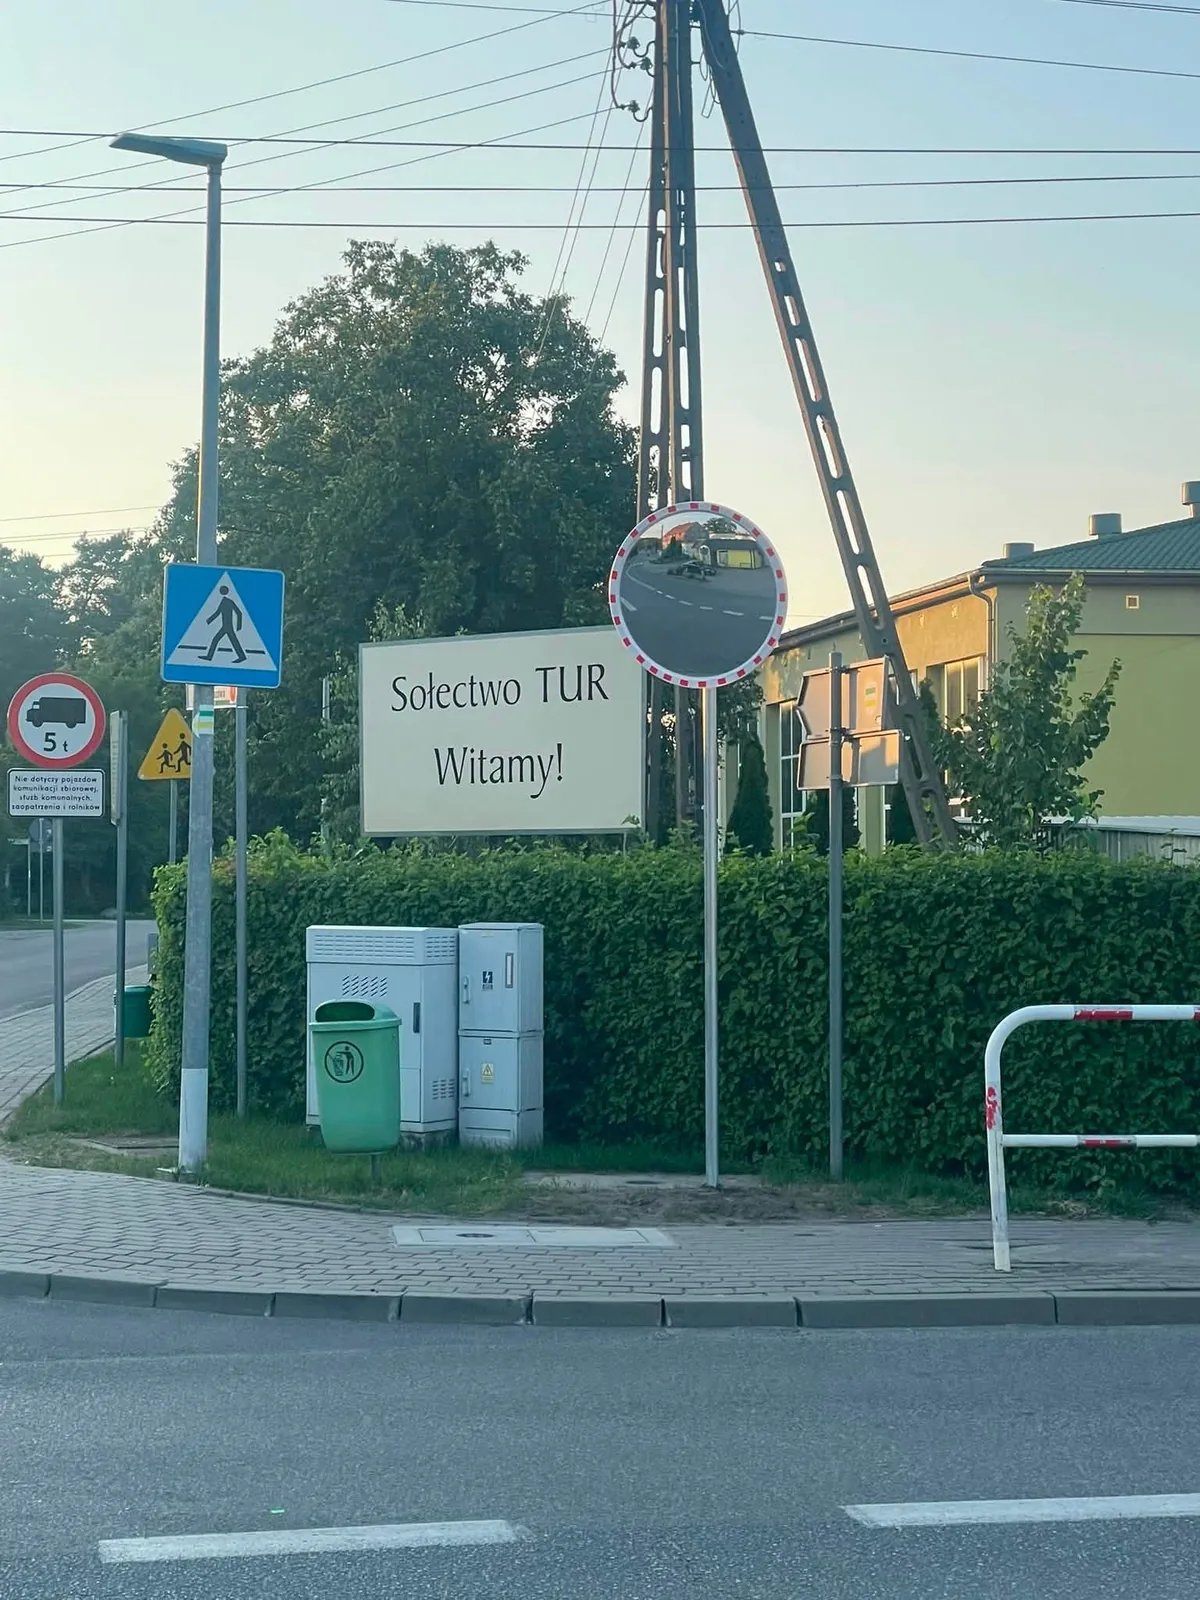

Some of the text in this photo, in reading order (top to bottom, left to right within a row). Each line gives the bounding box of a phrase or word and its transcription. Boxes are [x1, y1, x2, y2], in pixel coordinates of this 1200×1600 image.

[391, 663, 610, 712] Sołectwo TUR
[43, 732, 69, 752] 5 t
[433, 742, 563, 799] Witamy!
[15, 775, 28, 783] Nie
[30, 775, 59, 784] dotyczy
[13, 784, 58, 793] komunikacji
[12, 803, 61, 811] zaopatrzenia
[68, 803, 100, 811] rolników
